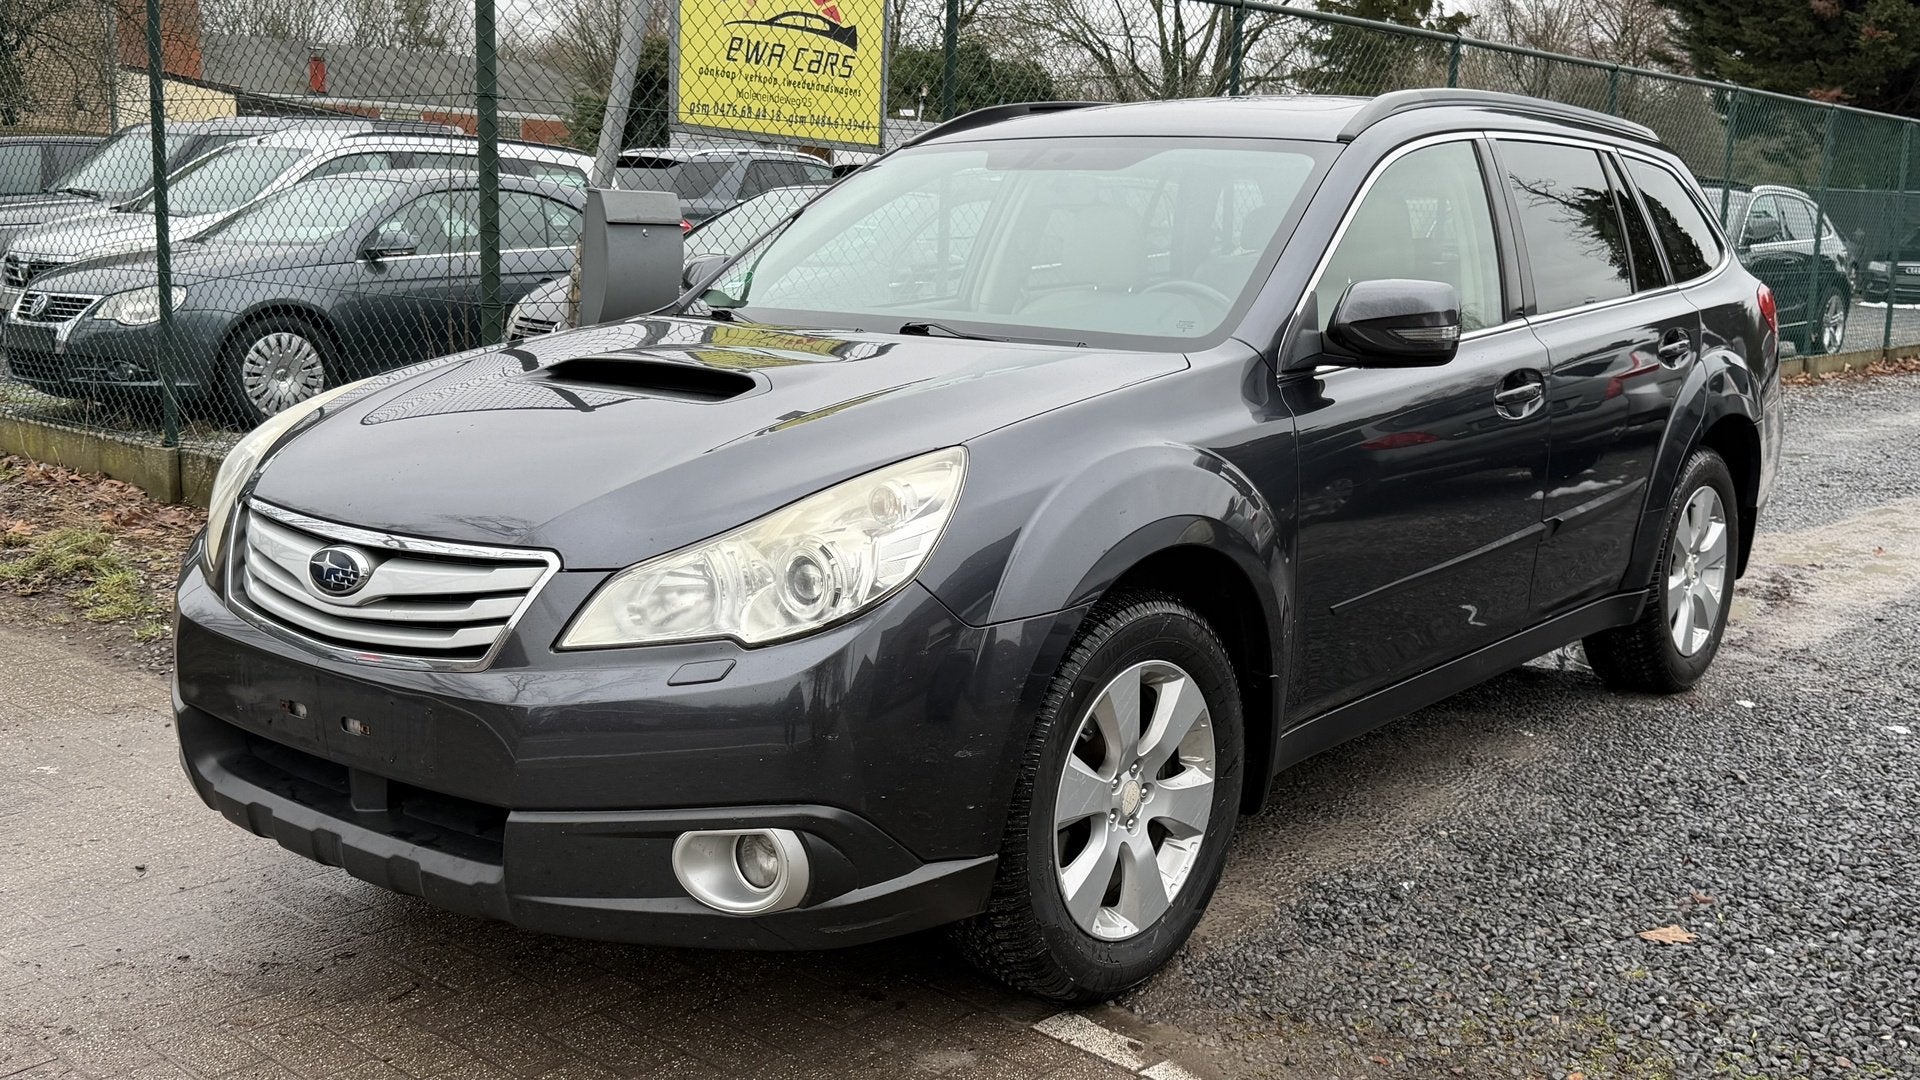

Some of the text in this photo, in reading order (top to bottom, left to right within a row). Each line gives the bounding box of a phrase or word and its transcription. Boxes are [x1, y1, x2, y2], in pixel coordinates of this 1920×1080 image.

[745, 72, 778, 88] verkoop
[783, 78, 862, 97] tweedehandswagens
[690, 102, 709, 115] gsm
